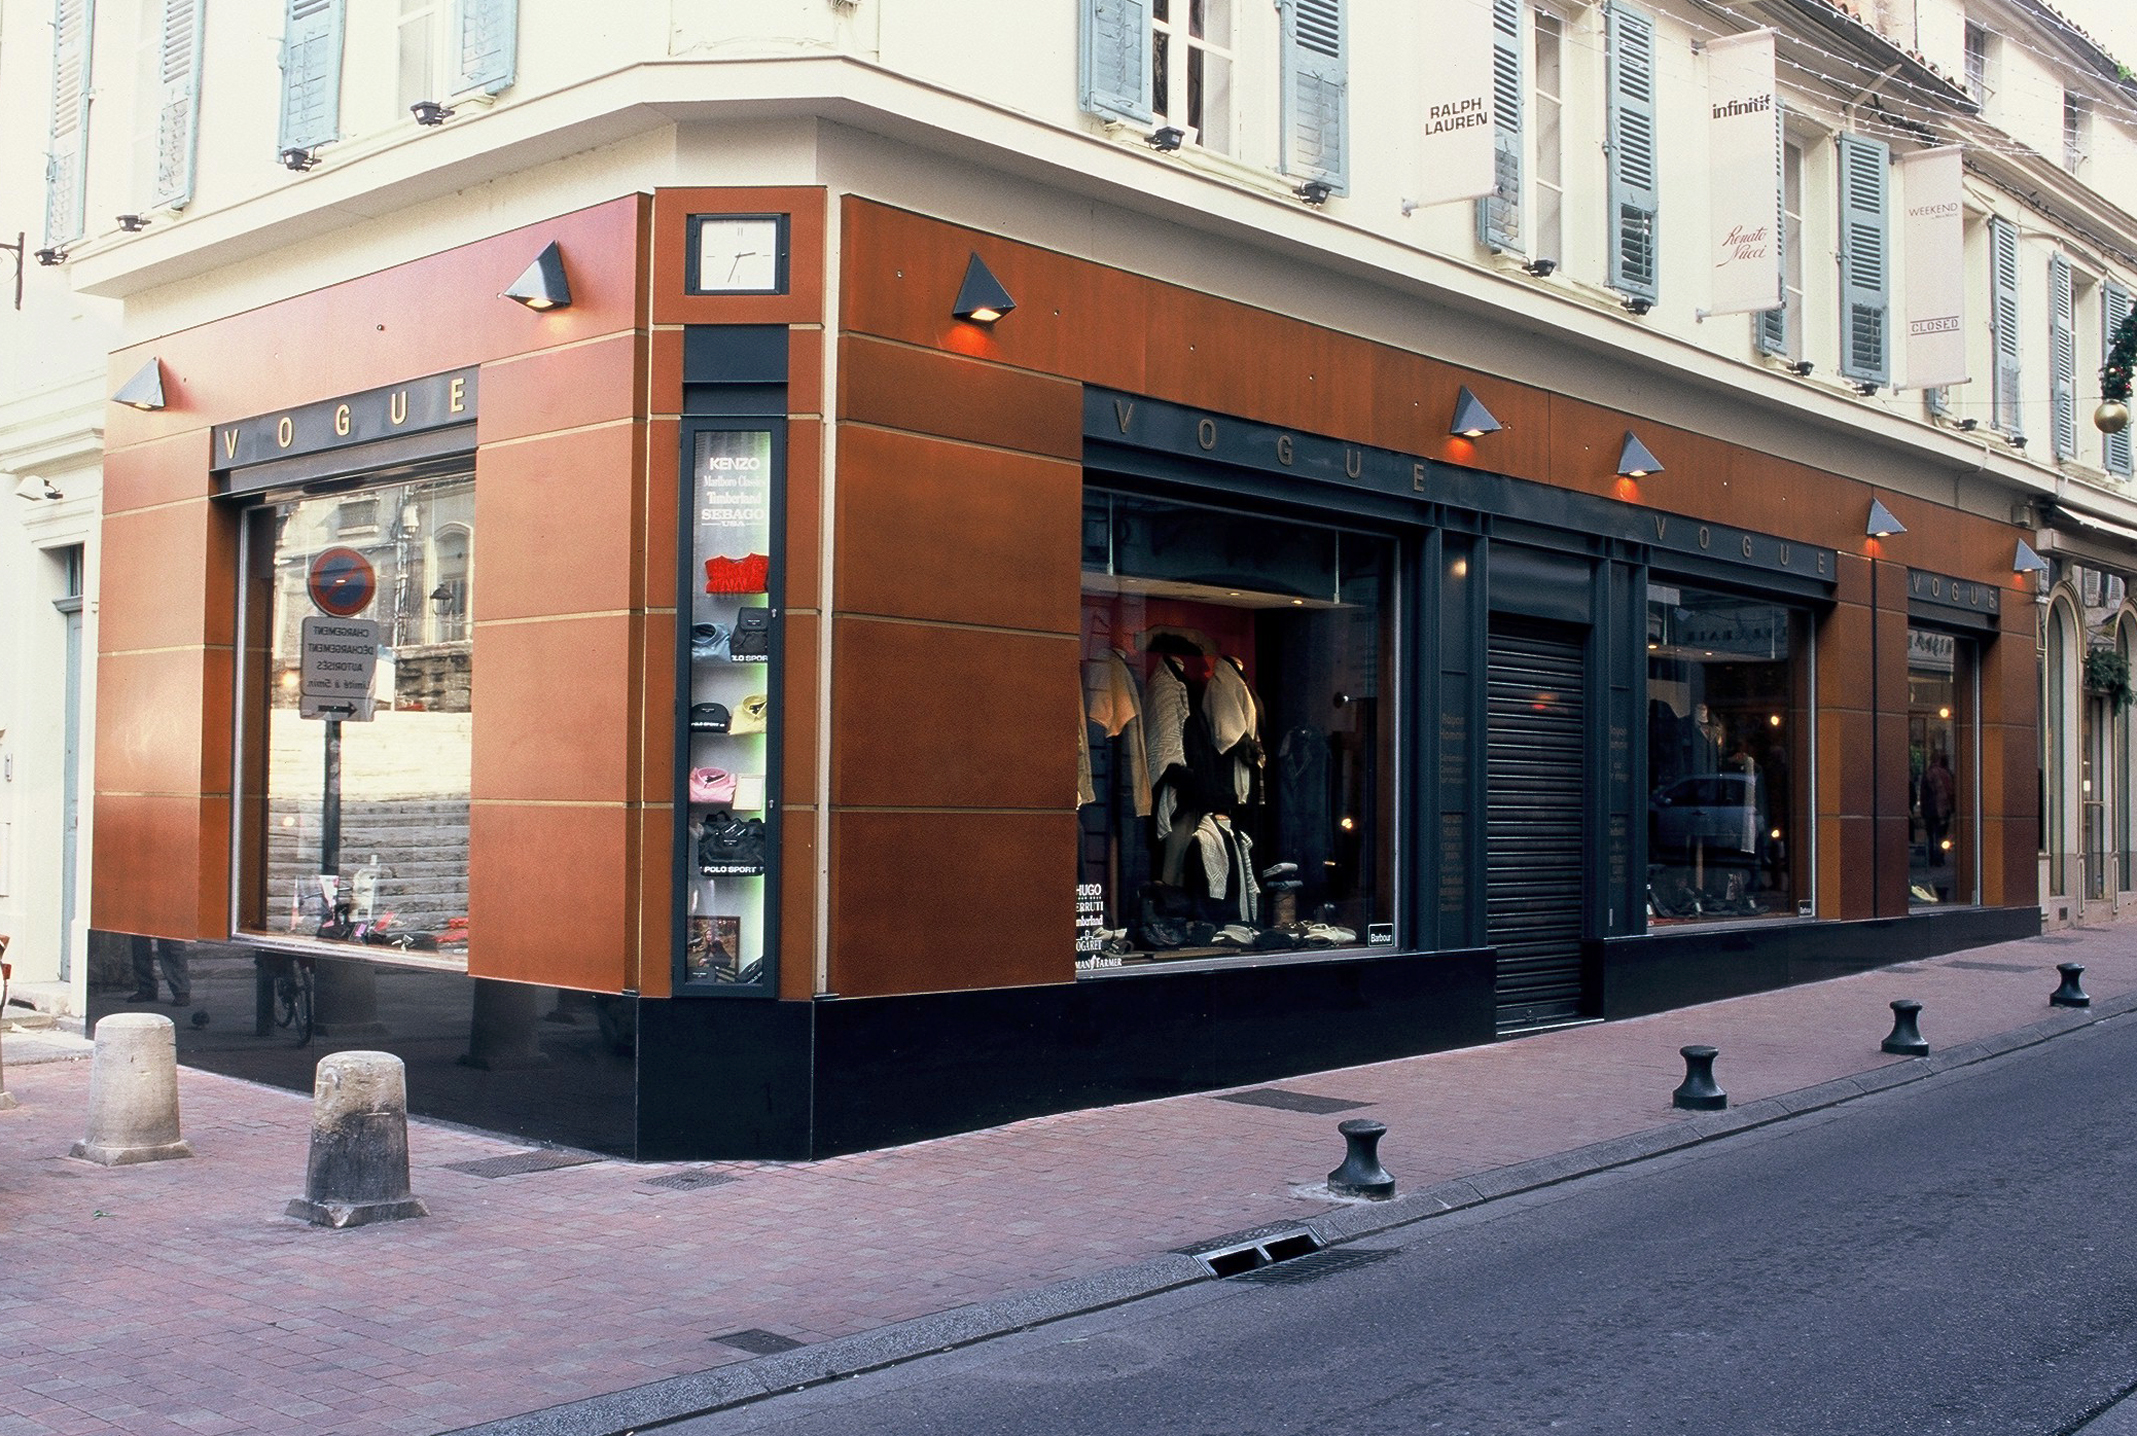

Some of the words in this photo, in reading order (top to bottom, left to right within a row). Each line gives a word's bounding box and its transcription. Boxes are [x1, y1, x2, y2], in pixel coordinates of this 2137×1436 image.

[1430, 97, 1482, 119] RALPH
[1712, 94, 1770, 119] infinitif
[1425, 111, 1488, 136] LAUREN
[1909, 202, 1958, 216] WEEKEND
[1722, 224, 1768, 247] Renato
[1716, 244, 1768, 268] Nucci
[1911, 318, 1959, 334] CLOSED
[224, 377, 466, 460] VOGUE
[1114, 399, 1427, 493] VOGUE
[709, 457, 761, 471] KENZO
[706, 491, 762, 505] Timberland
[701, 508, 765, 520] SEBAGO
[1654, 514, 1825, 574] VOGUE
[1912, 572, 1996, 609] VOGUE
[745, 654, 769, 662] SPOR
[1076, 884, 1102, 896] HUGO
[1076, 901, 1104, 912] ERRUTI
[1076, 914, 1104, 928] mberland
[1370, 933, 1392, 943] Barbour
[1075, 940, 1103, 952] OGARET
[1075, 959, 1091, 970] MAN
[1096, 957, 1123, 969] FARMER
